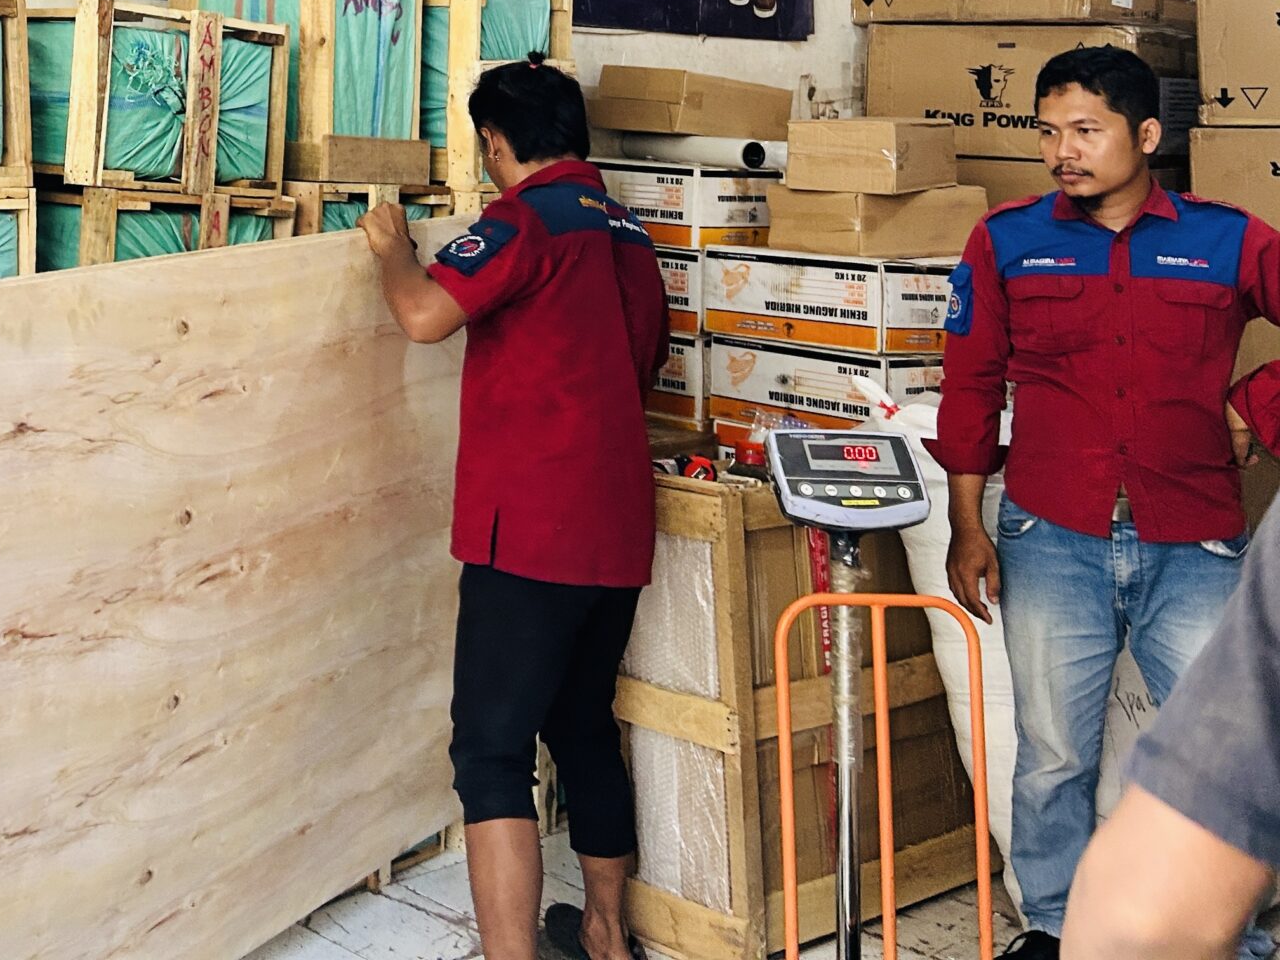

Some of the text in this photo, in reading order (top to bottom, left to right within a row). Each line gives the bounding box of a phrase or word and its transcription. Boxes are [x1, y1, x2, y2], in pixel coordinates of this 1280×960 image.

[196, 20, 215, 168] AMBON
[983, 111, 1039, 129] POWE
[660, 209, 684, 221] BENIH
[851, 273, 856, 281] X
[856, 273, 866, 282] 20
[764, 300, 868, 321] BENIH JAGUNG HIBRIDA
[768, 390, 804, 405] HIBRIDA
[806, 396, 842, 413] JAGUNG
[843, 404, 870, 417] BENIH
[844, 446, 877, 460] 0.00
[820, 605, 830, 645] FRAGI
